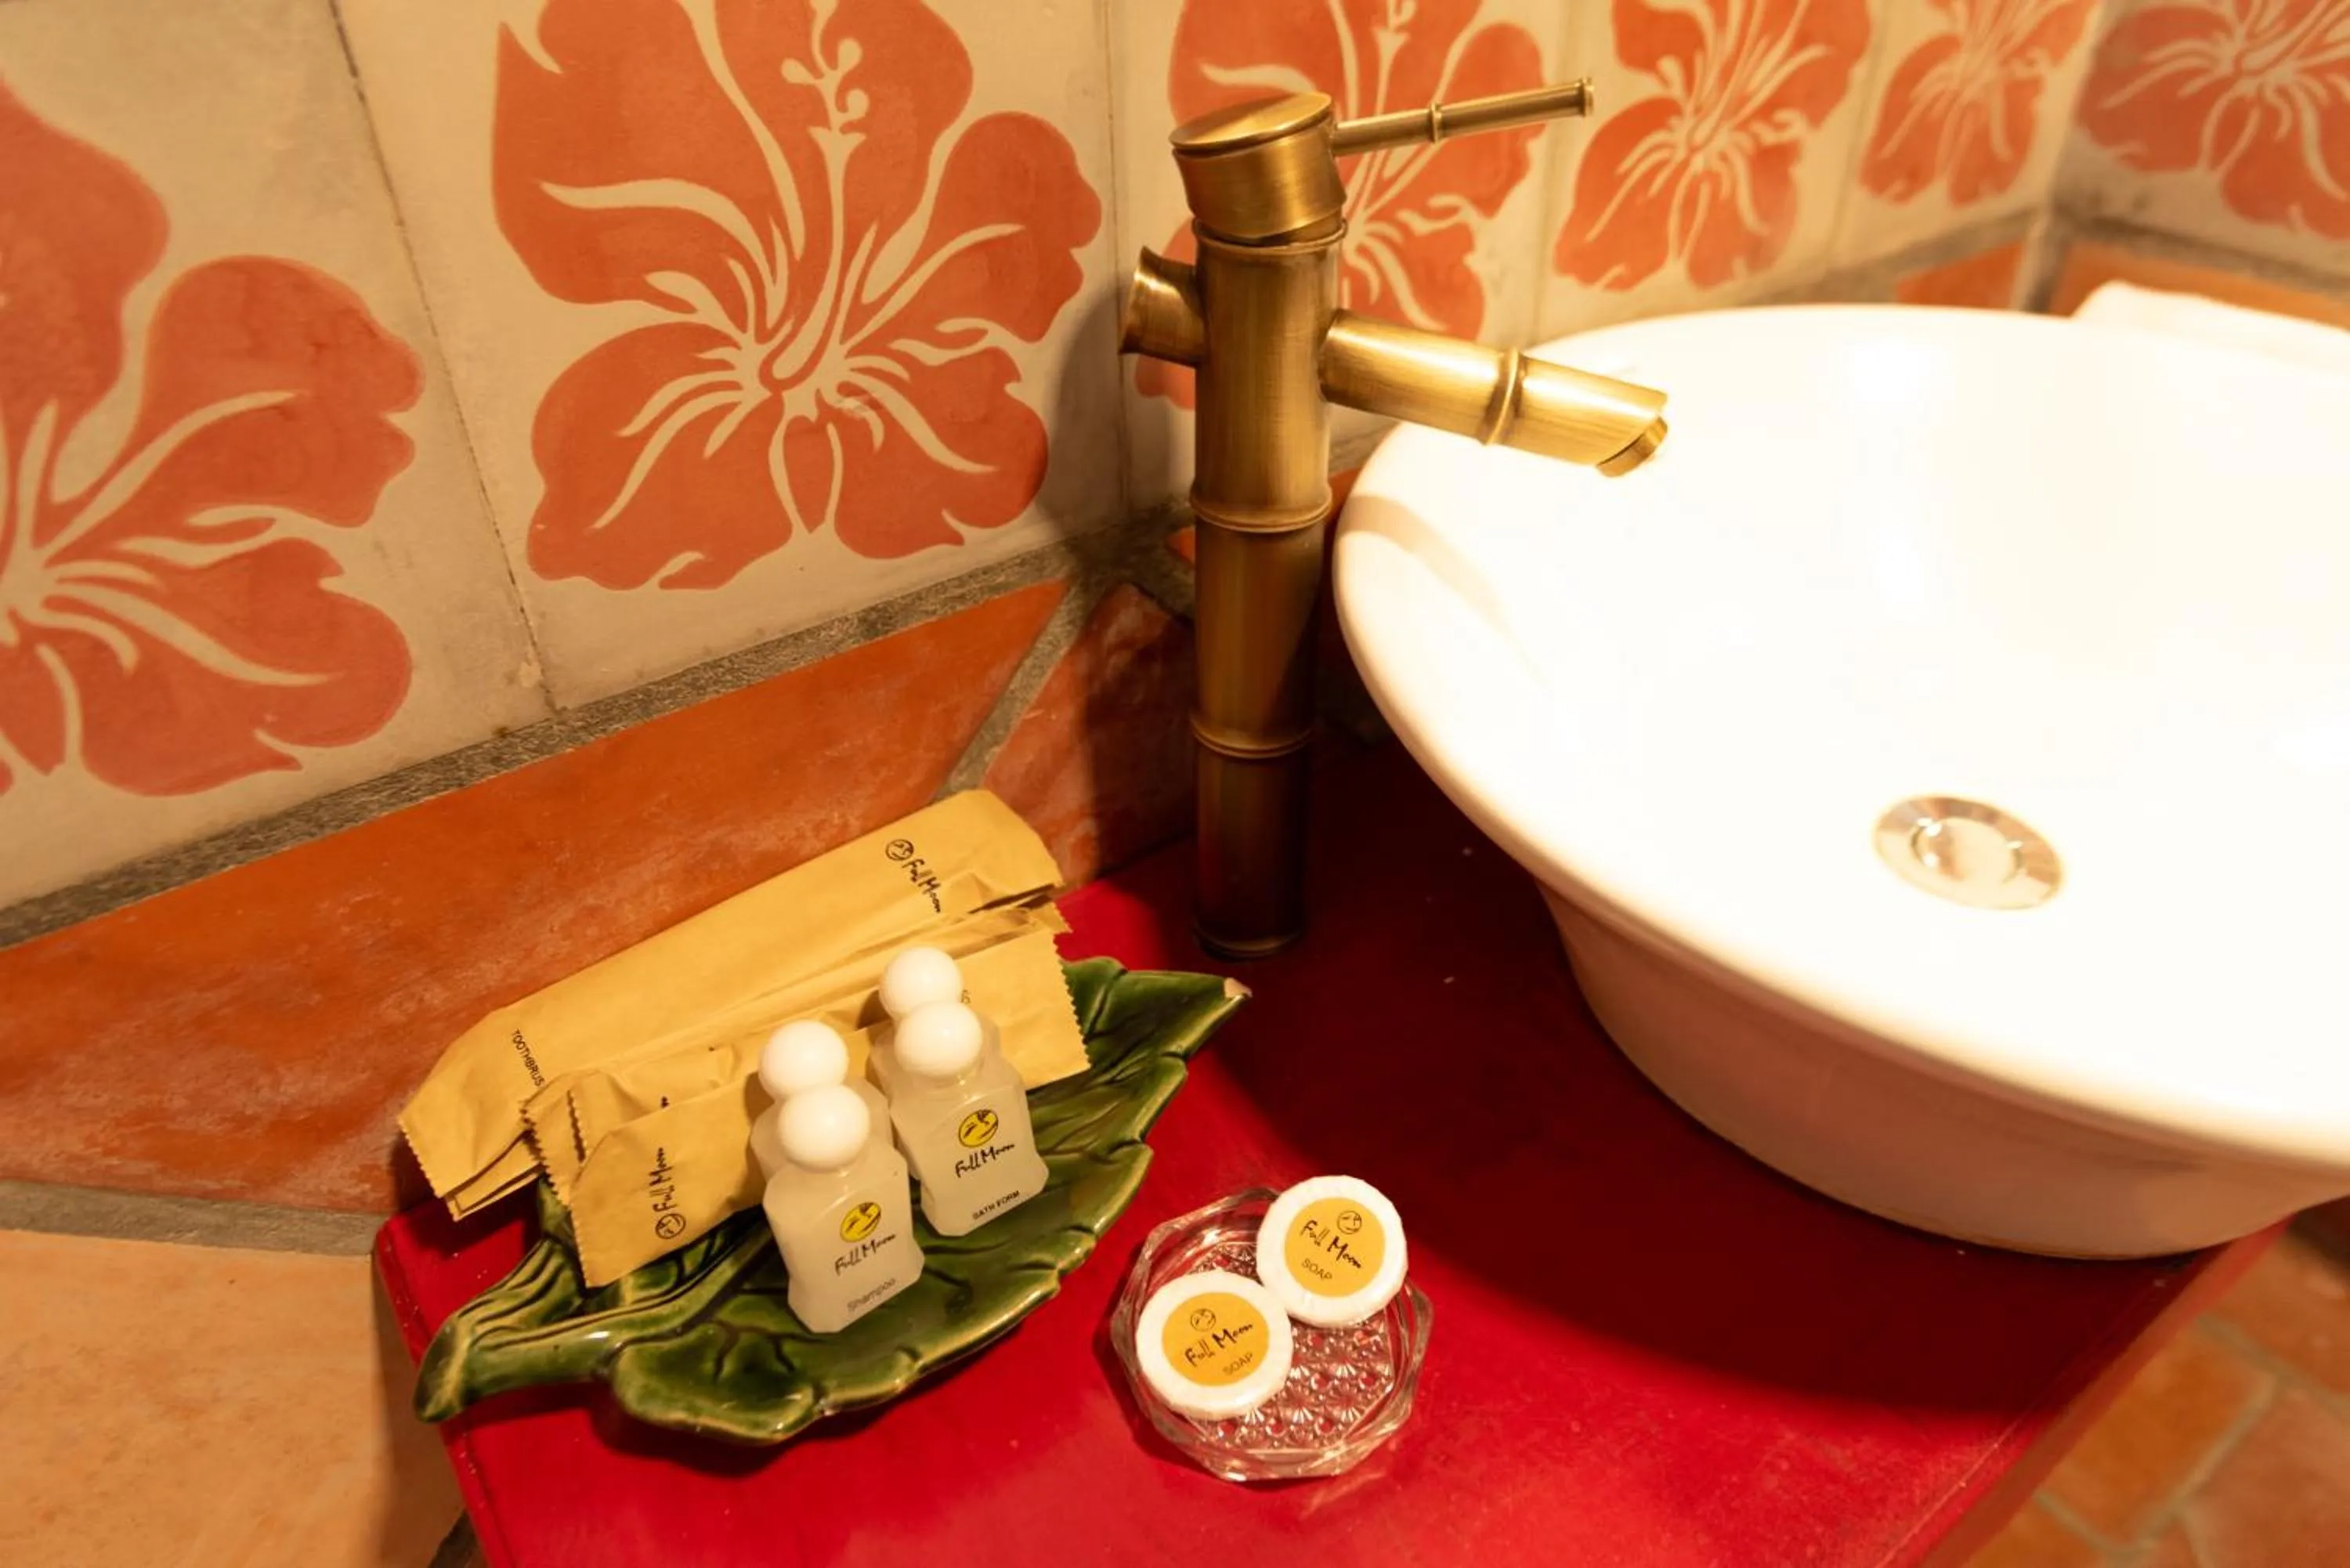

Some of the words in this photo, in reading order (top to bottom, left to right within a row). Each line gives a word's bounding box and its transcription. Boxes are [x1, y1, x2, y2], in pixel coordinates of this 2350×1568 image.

[512, 1028, 545, 1087] TOOTHBRUS
[955, 1152, 981, 1178] Full
[648, 1185, 678, 1212] Full
[972, 1202, 996, 1220] BATH
[996, 1190, 1020, 1208] FORM
[1300, 1219, 1330, 1247] Full
[834, 1247, 862, 1277] Full
[1301, 1258, 1332, 1281] SOAP
[1184, 1339, 1215, 1367] Full
[1211, 1324, 1253, 1349] Moon
[1222, 1353, 1253, 1375] SOAP
